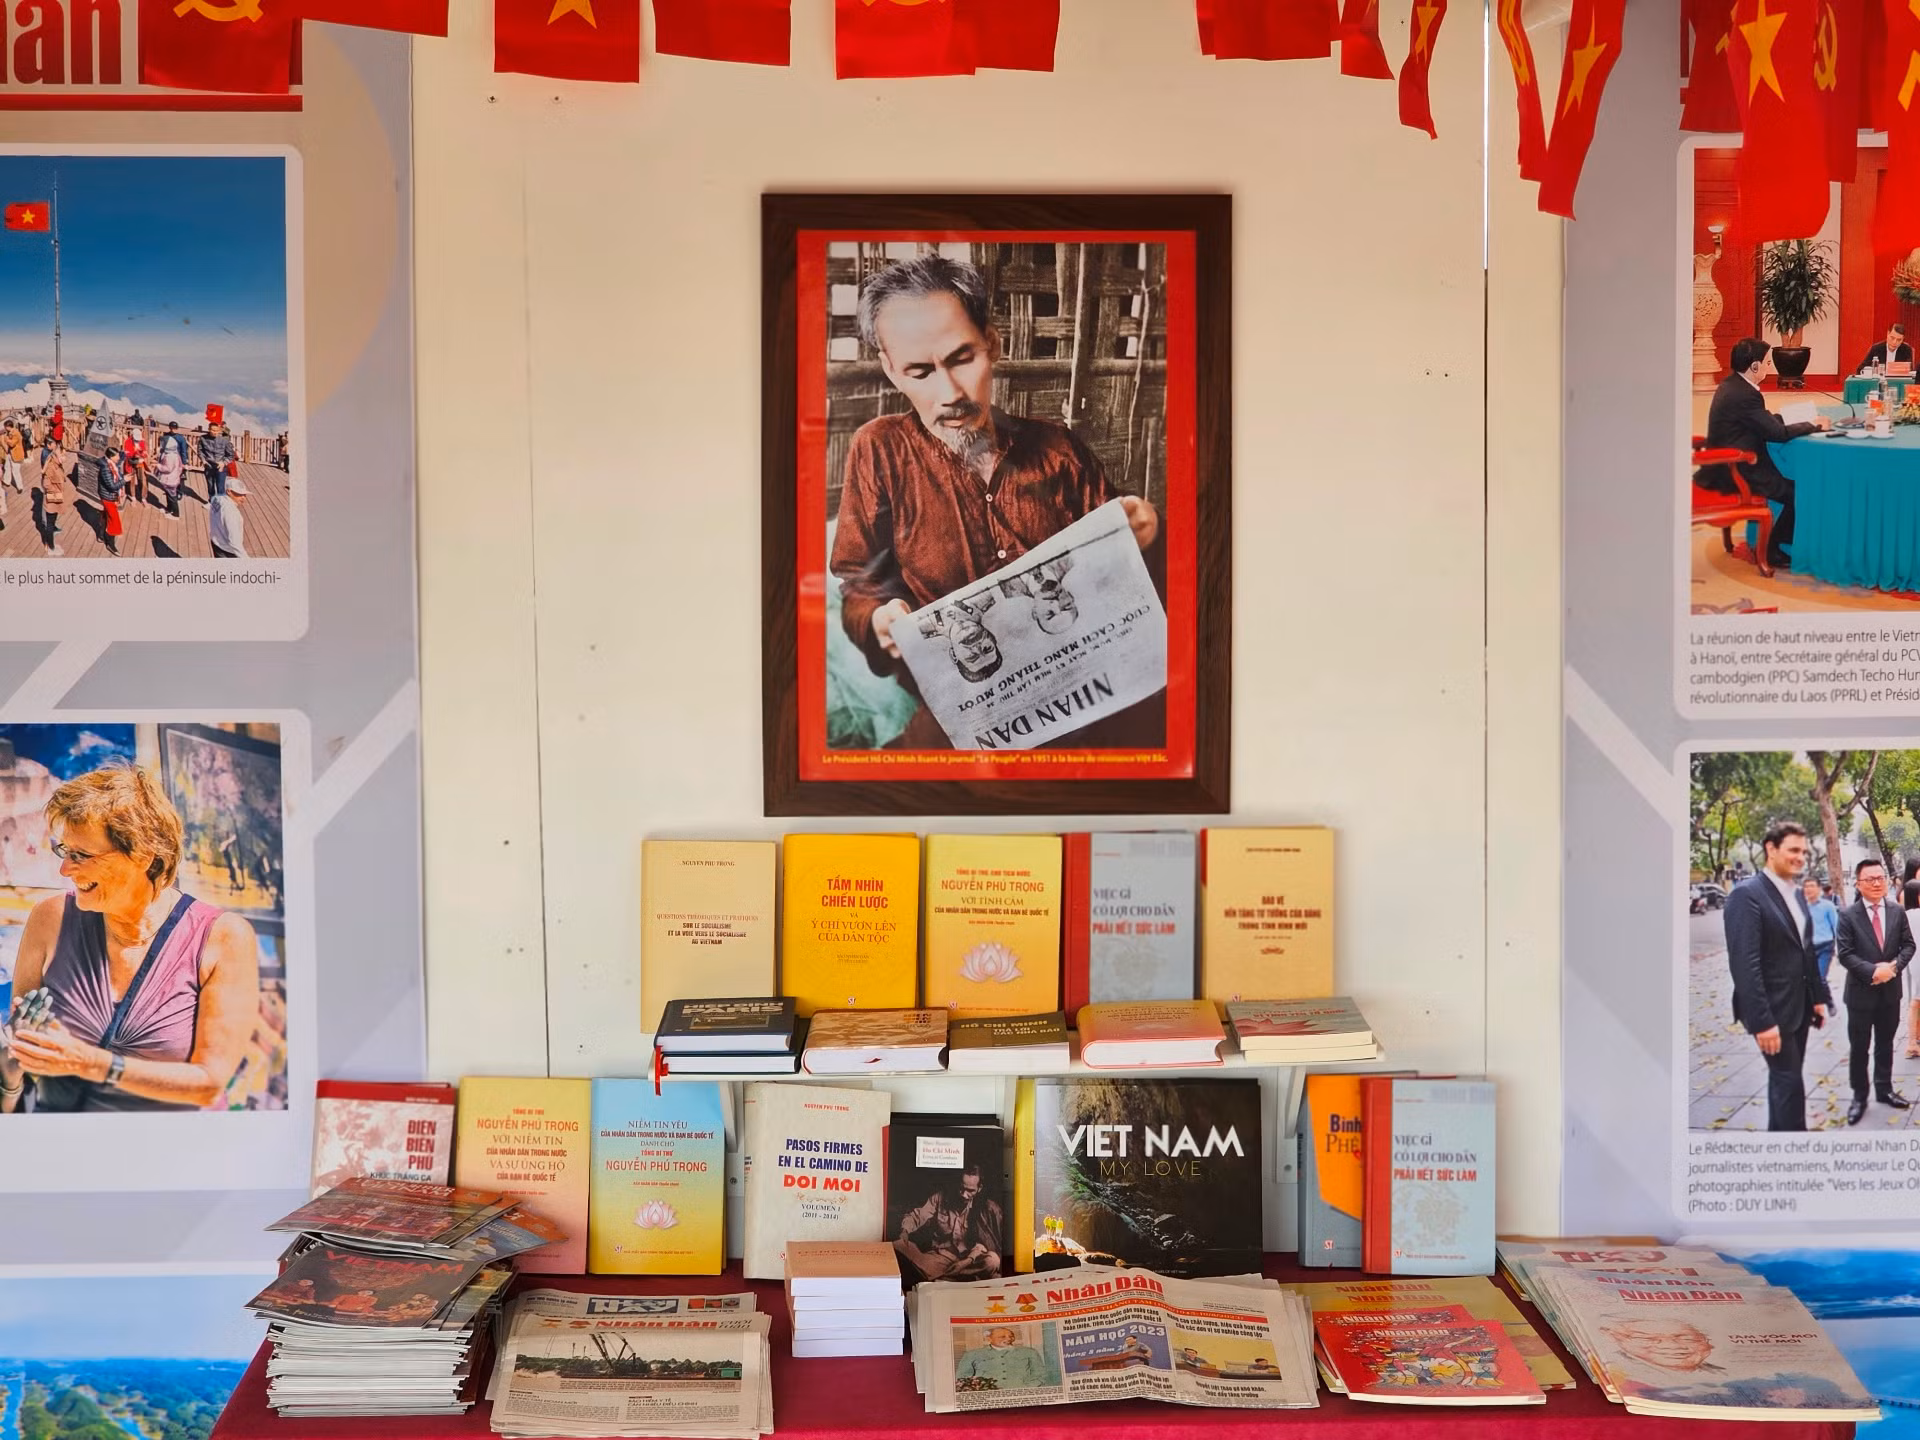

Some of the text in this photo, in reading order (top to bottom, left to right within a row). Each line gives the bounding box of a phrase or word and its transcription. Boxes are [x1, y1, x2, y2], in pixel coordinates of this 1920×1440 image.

[0, 0, 121, 84] an
[4, 570, 282, 587] le plus haut sommet de la péninsule indochi-
[1691, 633, 1703, 645] La
[1707, 631, 1752, 644] réunion
[1756, 630, 1771, 643] de
[1774, 630, 1800, 643] haut
[1804, 631, 1842, 643] niveau
[1846, 631, 1876, 642] entre
[1880, 629, 1890, 642] le
[1690, 653, 1697, 665] à
[1700, 651, 1738, 666] Hanoï,
[1741, 652, 1771, 664] entre
[1775, 650, 1831, 664] Secrétaire
[1835, 650, 1878, 665] général
[1882, 649, 1897, 662] du
[1690, 671, 1765, 686] cambodgien
[1768, 670, 1799, 685] (PPC)
[1803, 669, 1857, 682] Samdech
[1860, 669, 1894, 681] Techo
[1691, 689, 1920, 704] révolutionnaire du Laos (PPRL) et Présid
[786, 1139, 863, 1155] PASOS FIRMES
[1056, 1125, 1244, 1157] VIET NAM
[1689, 1139, 1920, 1155] Le Rédacteur en chef du journal Nhan D
[778, 1155, 868, 1173] EN EL CAMINO DE
[1100, 1160, 1200, 1176] MY LOVE
[1688, 1161, 1754, 1177] journalistes
[1757, 1161, 1831, 1174] vietnamiens,
[1833, 1160, 1888, 1172] Monsieur
[1891, 1159, 1904, 1171] Le
[783, 1175, 860, 1192] DOI MOI
[1689, 1181, 1773, 1195] photographies
[1776, 1180, 1824, 1192] intitulée
[1859, 1179, 1874, 1191] les
[1877, 1178, 1903, 1191] Jeux
[1688, 1200, 1727, 1213] (Photo
[1736, 1199, 1761, 1212] DUY
[1765, 1198, 1797, 1212] LINH)
[327, 1250, 464, 1276] VIETNAM
[1047, 1281, 1111, 1303] Nhân
[1115, 1275, 1162, 1292] Dân
[1130, 1325, 1165, 1336] 2023
